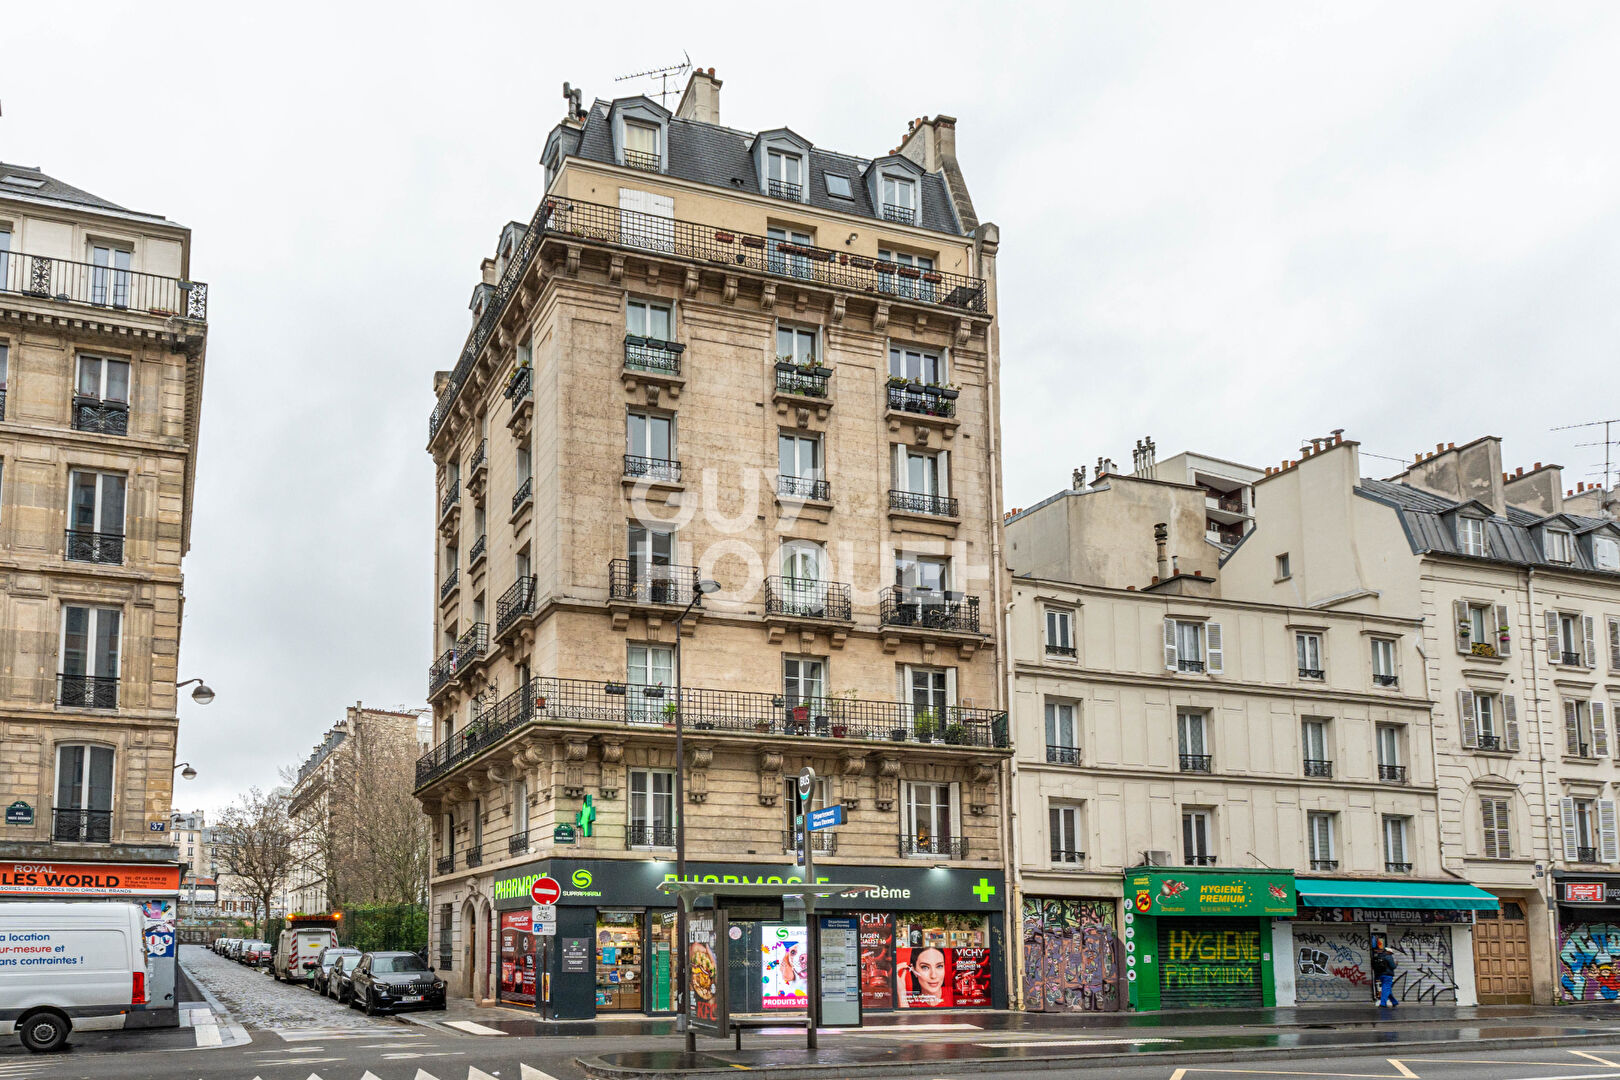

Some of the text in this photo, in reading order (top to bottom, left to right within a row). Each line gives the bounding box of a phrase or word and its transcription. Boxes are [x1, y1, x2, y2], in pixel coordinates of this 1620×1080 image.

[800, 774, 810, 787] BUS
[151, 822, 163, 831] 37
[13, 864, 57, 874] ROYAL
[2, 873, 120, 888] LES WORLD
[1200, 885, 1244, 894] HYGIENE
[1199, 894, 1246, 903] PREMIUM
[1333, 907, 1364, 922] SKR
[9, 933, 50, 942] location
[54, 945, 65, 953] et
[1168, 930, 1260, 960] HYGIENE
[956, 948, 985, 957] VICHY
[20, 956, 77, 965] contraintes
[1165, 963, 1254, 990] PREMIUM
[696, 1001, 717, 1021] KFC
